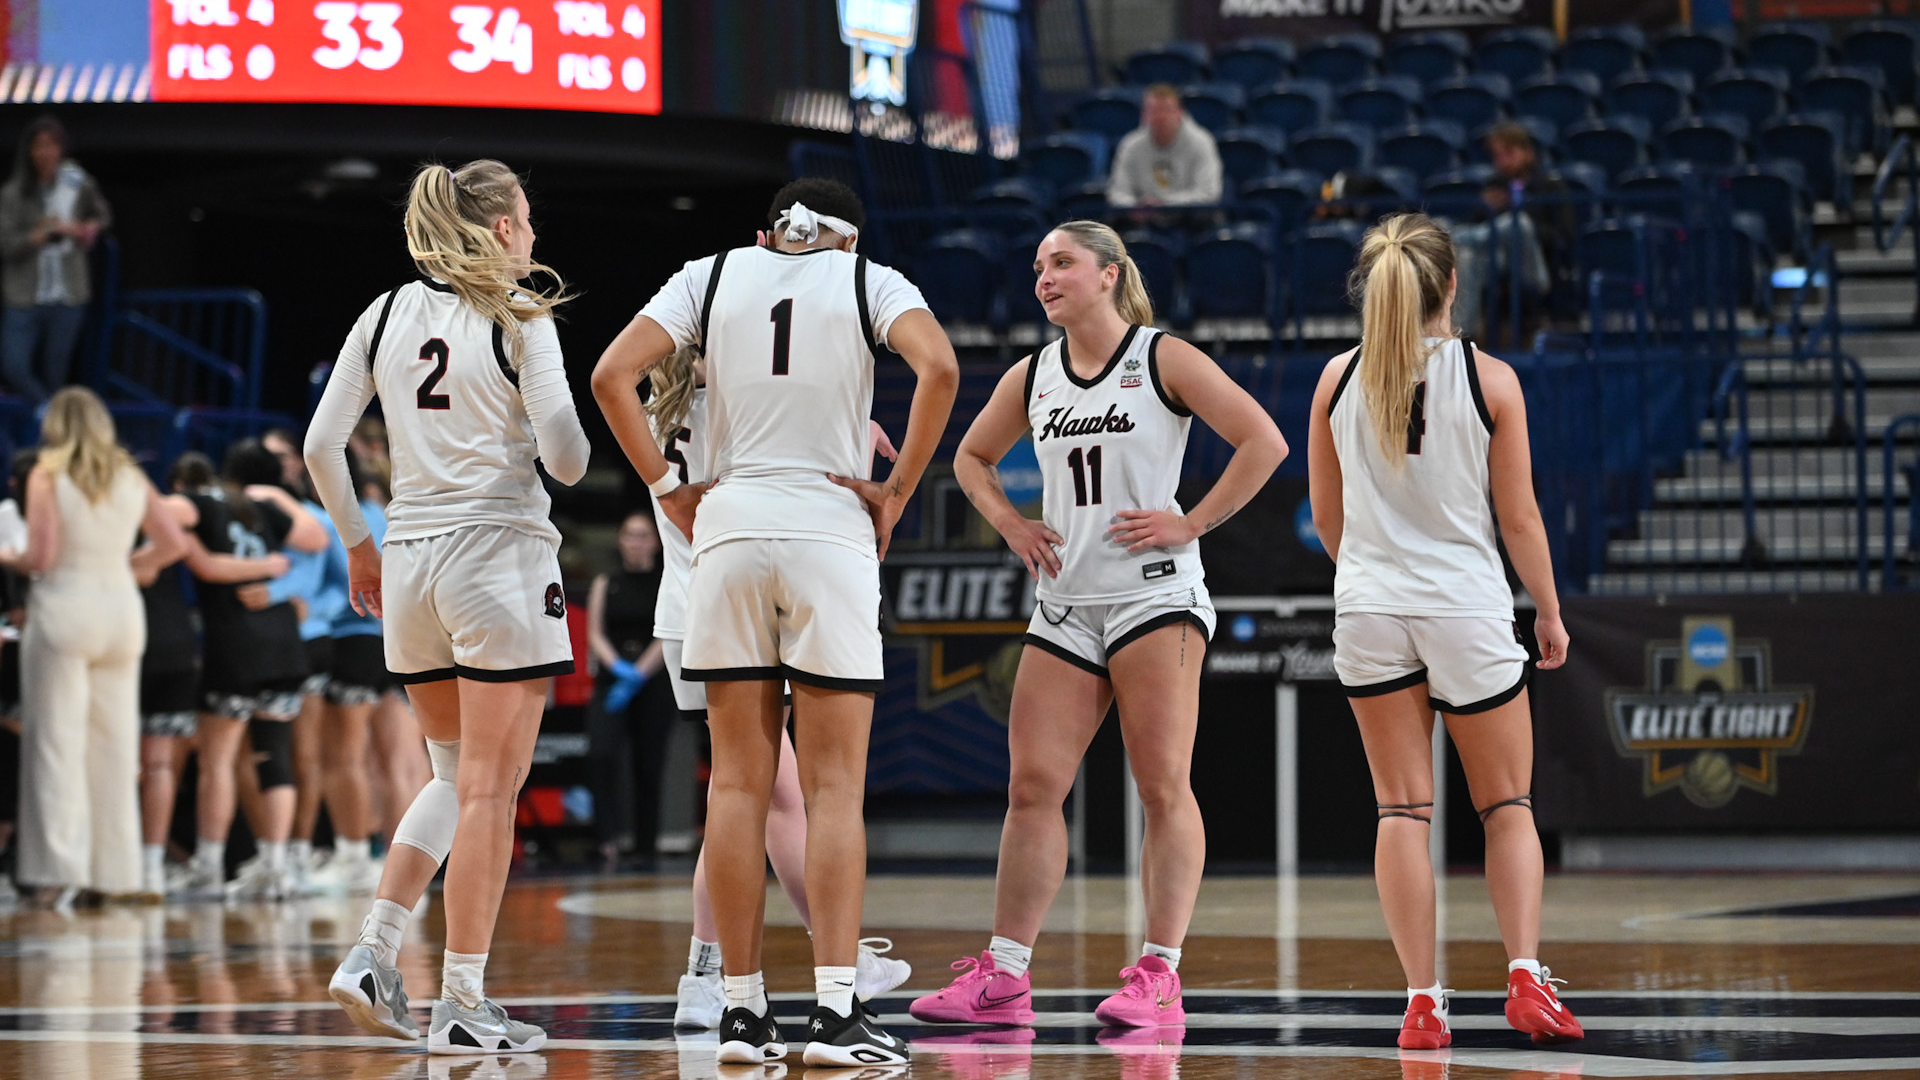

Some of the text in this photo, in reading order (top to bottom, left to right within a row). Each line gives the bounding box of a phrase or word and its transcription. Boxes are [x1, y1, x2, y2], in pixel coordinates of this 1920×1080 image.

[166, 0, 274, 26] TOL 4
[553, 0, 646, 40] TOL 4
[312, 1, 404, 70] 33
[448, 5, 533, 75] 34
[167, 43, 275, 81] FLS 0
[558, 53, 646, 92] FLS 0
[770, 298, 793, 376] 1
[417, 337, 450, 410] 2
[1120, 377, 1143, 385] PSAC
[1039, 403, 1136, 442] Hawks
[1067, 445, 1102, 507] 11
[896, 568, 1017, 620] ELITE
[1630, 703, 1794, 740] ELITE EIGHT
